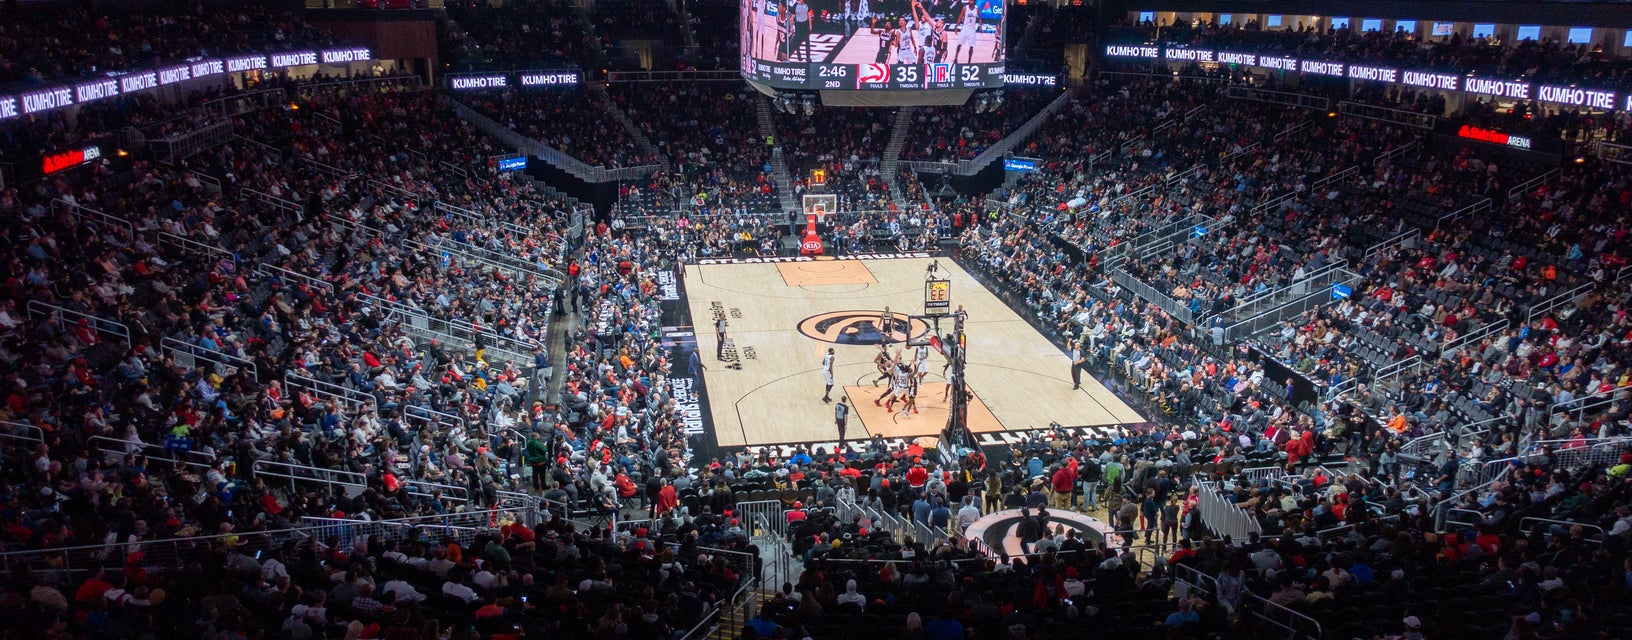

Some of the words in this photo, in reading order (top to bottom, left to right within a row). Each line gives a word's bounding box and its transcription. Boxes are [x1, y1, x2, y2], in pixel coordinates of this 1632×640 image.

[324, 51, 353, 62] KUMHO
[353, 49, 370, 60] TIRE
[1107, 46, 1139, 56] KUMHO
[1140, 47, 1158, 57] TIRE
[1166, 49, 1195, 60] KUMHO
[1196, 51, 1213, 61] TIRE
[1218, 52, 1243, 64] KUMHO
[1243, 55, 1255, 65] TIRE
[229, 59, 250, 71] KUMHO
[250, 57, 267, 69] TIRE
[273, 55, 300, 67] KUMHO
[300, 53, 317, 64] TIRE
[1260, 56, 1282, 69] KUMHO
[1282, 59, 1296, 70] TIRE
[193, 63, 210, 77] KUMHO
[210, 61, 224, 73] TIRE
[819, 66, 846, 77] 2:46
[896, 66, 917, 82] 35
[962, 66, 979, 80] 52
[1302, 61, 1327, 74] KUMHO
[1327, 63, 1343, 76] TIRE
[1349, 66, 1377, 80] KUMHO
[1378, 69, 1396, 82] TIRE
[123, 75, 144, 92] KUMHO
[144, 72, 157, 88] TIRE
[161, 69, 179, 85] KUMHO
[179, 67, 190, 80] TIRE
[453, 78, 487, 88] KUMHO
[487, 77, 506, 87] TIRE
[522, 75, 557, 85] KUMHO
[557, 74, 577, 84] TIRE
[1004, 74, 1035, 84] KUMHO
[1403, 71, 1436, 87] KUMHO
[1437, 75, 1457, 90] TIRE
[78, 83, 103, 102] KUMHO
[104, 81, 119, 96] TIRE
[1465, 78, 1503, 95] KUMHO
[1505, 82, 1529, 98] TIRE
[24, 92, 54, 113] KUMHO
[55, 88, 73, 107] TIRE
[1539, 86, 1584, 105] KUMHO
[1586, 91, 1614, 109] TIRE
[1507, 135, 1530, 148] ARENA
[698, 254, 812, 264] ATLANTA
[838, 252, 930, 261] HAWKS
